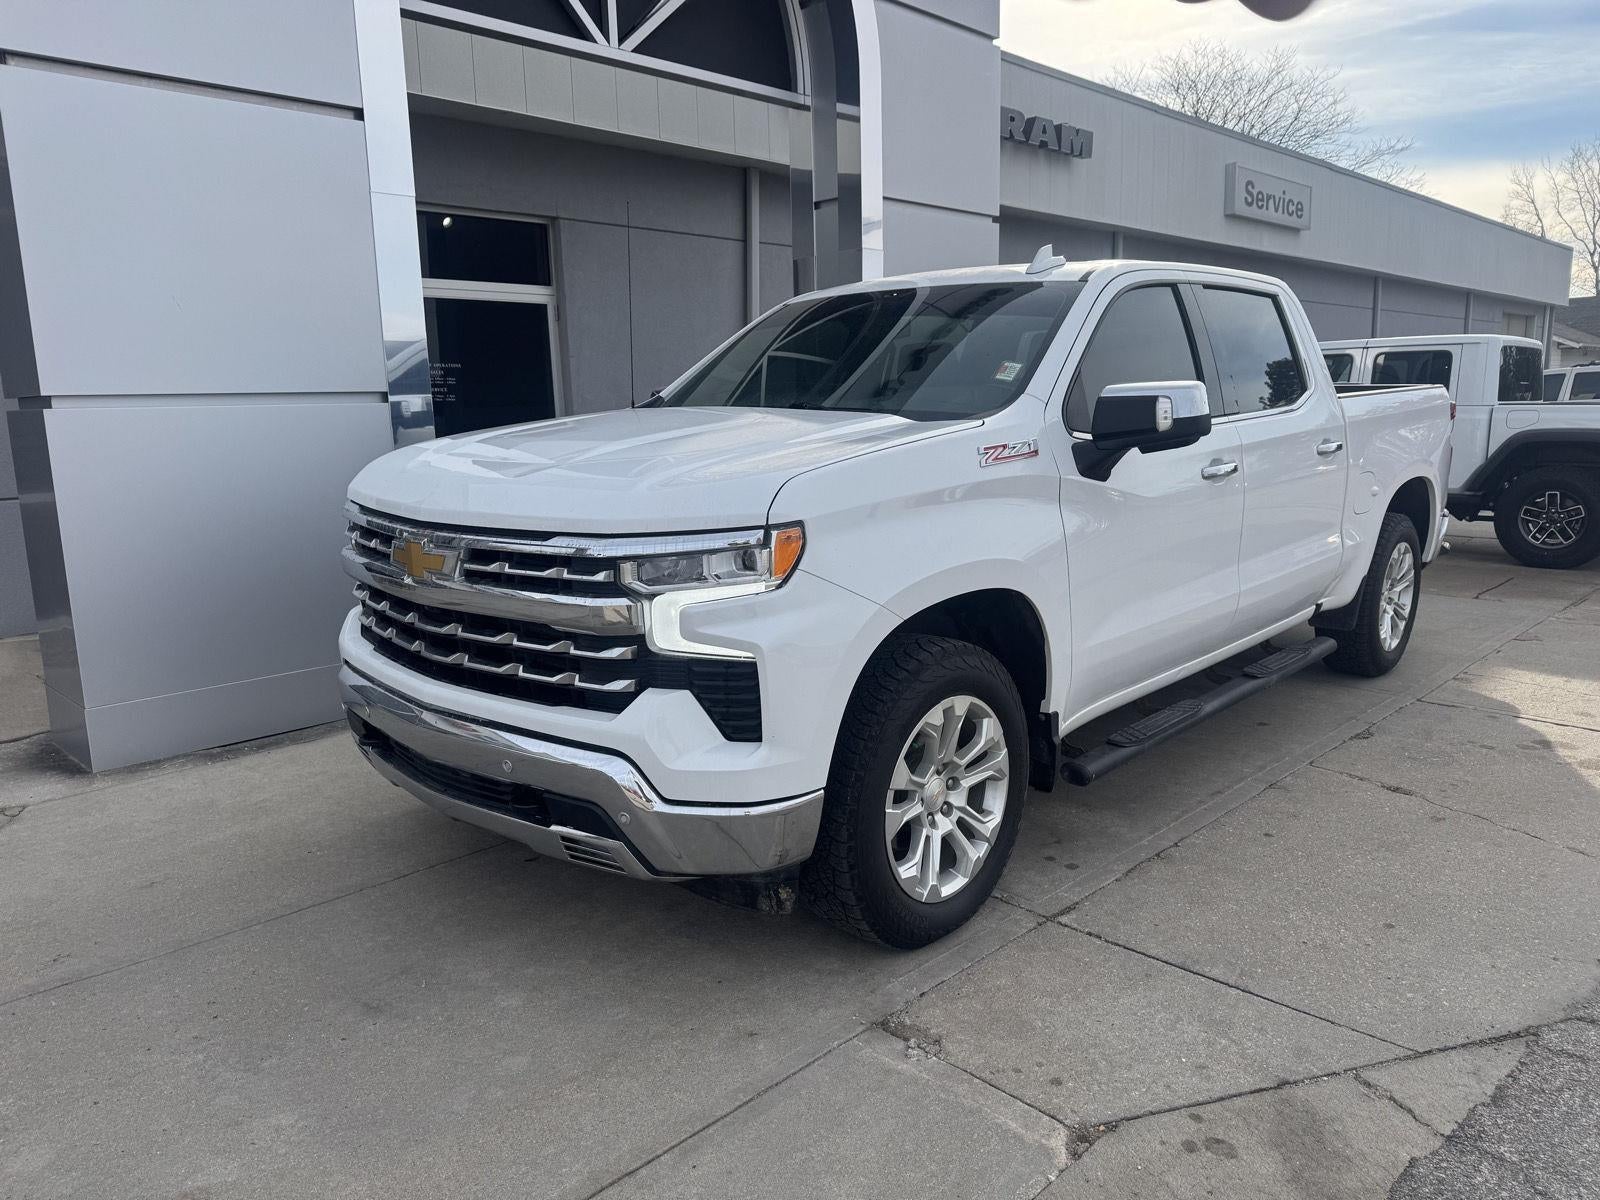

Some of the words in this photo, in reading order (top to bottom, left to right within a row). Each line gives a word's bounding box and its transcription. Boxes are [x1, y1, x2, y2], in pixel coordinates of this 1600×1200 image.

[1000, 105, 1093, 159] RAM
[1244, 180, 1304, 219] Service
[977, 439, 1039, 468] Z71
